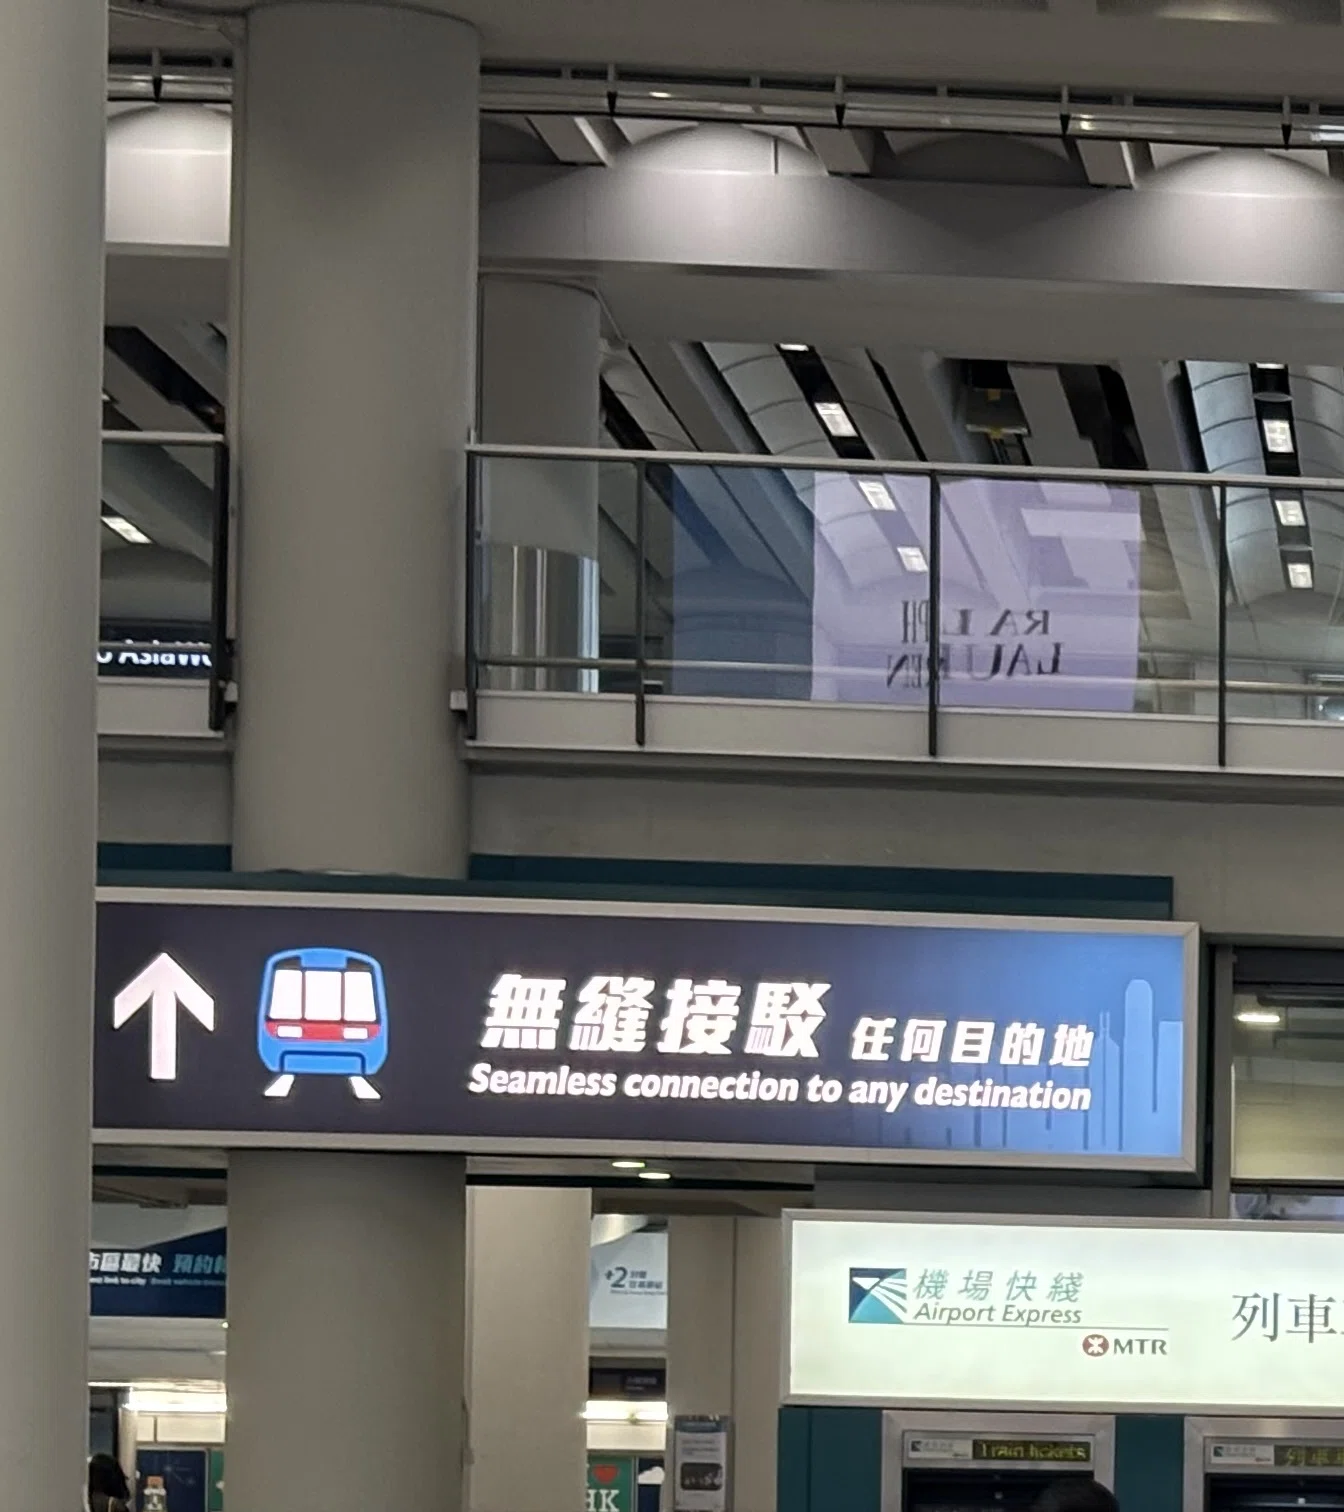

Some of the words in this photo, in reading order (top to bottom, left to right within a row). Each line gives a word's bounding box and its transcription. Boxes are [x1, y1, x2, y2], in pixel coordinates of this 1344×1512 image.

[481, 973, 831, 1058] 無縫接駁
[851, 1016, 1095, 1067] 任何目的地
[468, 1062, 618, 1097] Seamless
[624, 1070, 800, 1102] connection
[807, 1074, 843, 1104] to
[849, 1079, 909, 1113] any
[914, 1076, 1092, 1110] destination
[914, 1269, 1085, 1303] 機場快綫
[913, 1302, 997, 1326] Airport
[1002, 1304, 1083, 1327] Express
[1113, 1338, 1168, 1356] MTR
